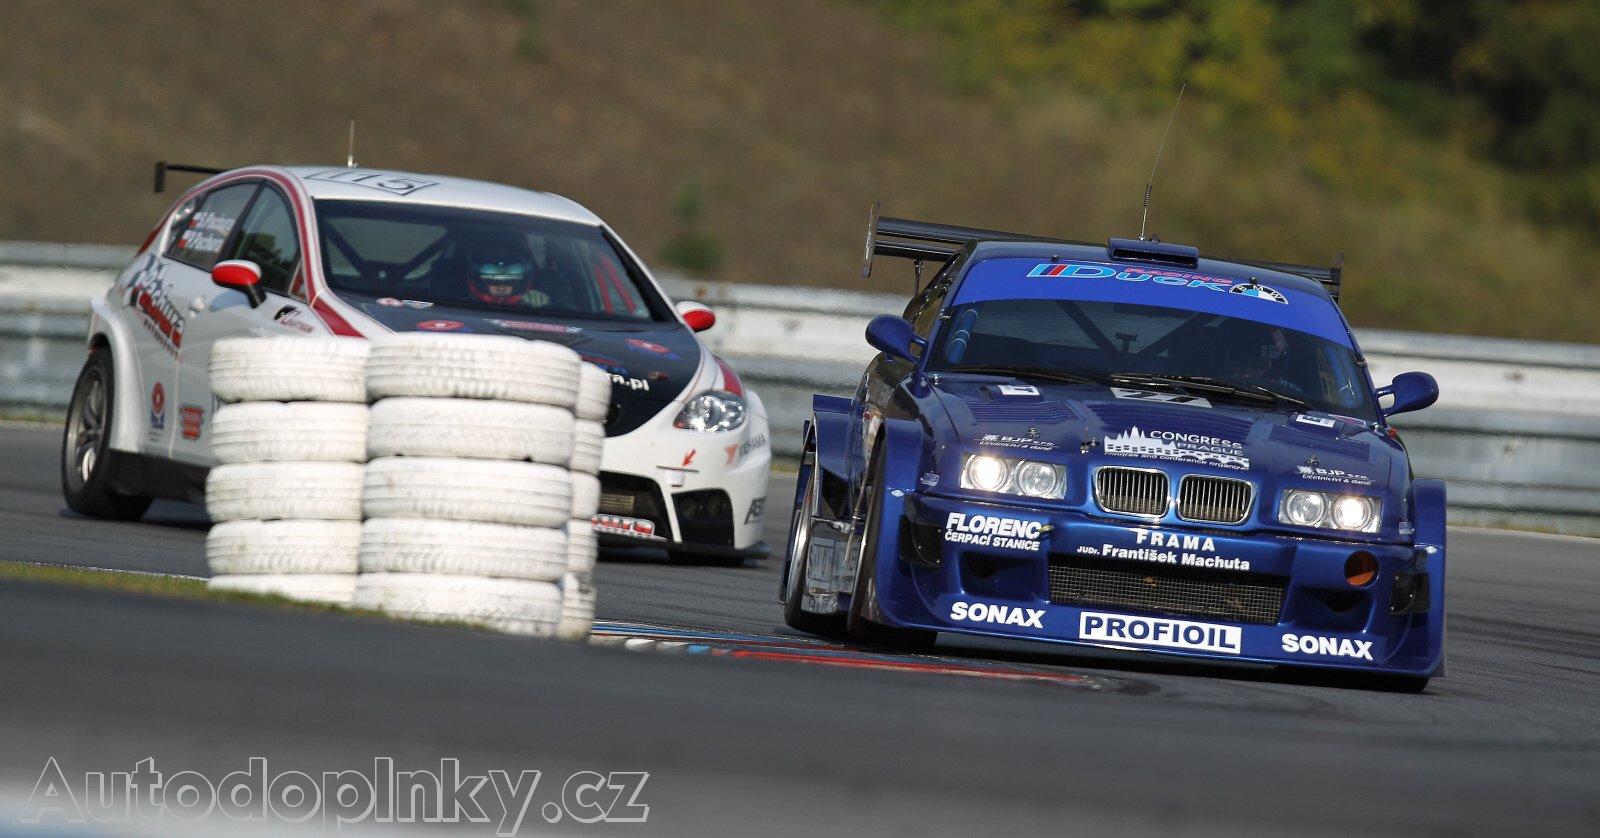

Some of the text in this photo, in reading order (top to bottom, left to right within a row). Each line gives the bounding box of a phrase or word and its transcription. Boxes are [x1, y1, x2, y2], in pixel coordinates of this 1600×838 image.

[1125, 267, 1234, 284] RACING
[1236, 283, 1286, 303] BMW
[1150, 430, 1243, 450] CONGRESS
[1177, 442, 1244, 457] PRAGUE
[1315, 467, 1345, 476] BJP
[946, 512, 1042, 540] FLORENC
[944, 527, 1040, 551] ČERPACÍ STANICE
[1136, 530, 1216, 552] FRAMA
[1102, 543, 1178, 565] František
[1181, 552, 1250, 571] Machuta
[950, 601, 1046, 629] SONAX
[1083, 615, 1237, 651] PROFIOIL
[1281, 633, 1374, 662] SONAX
